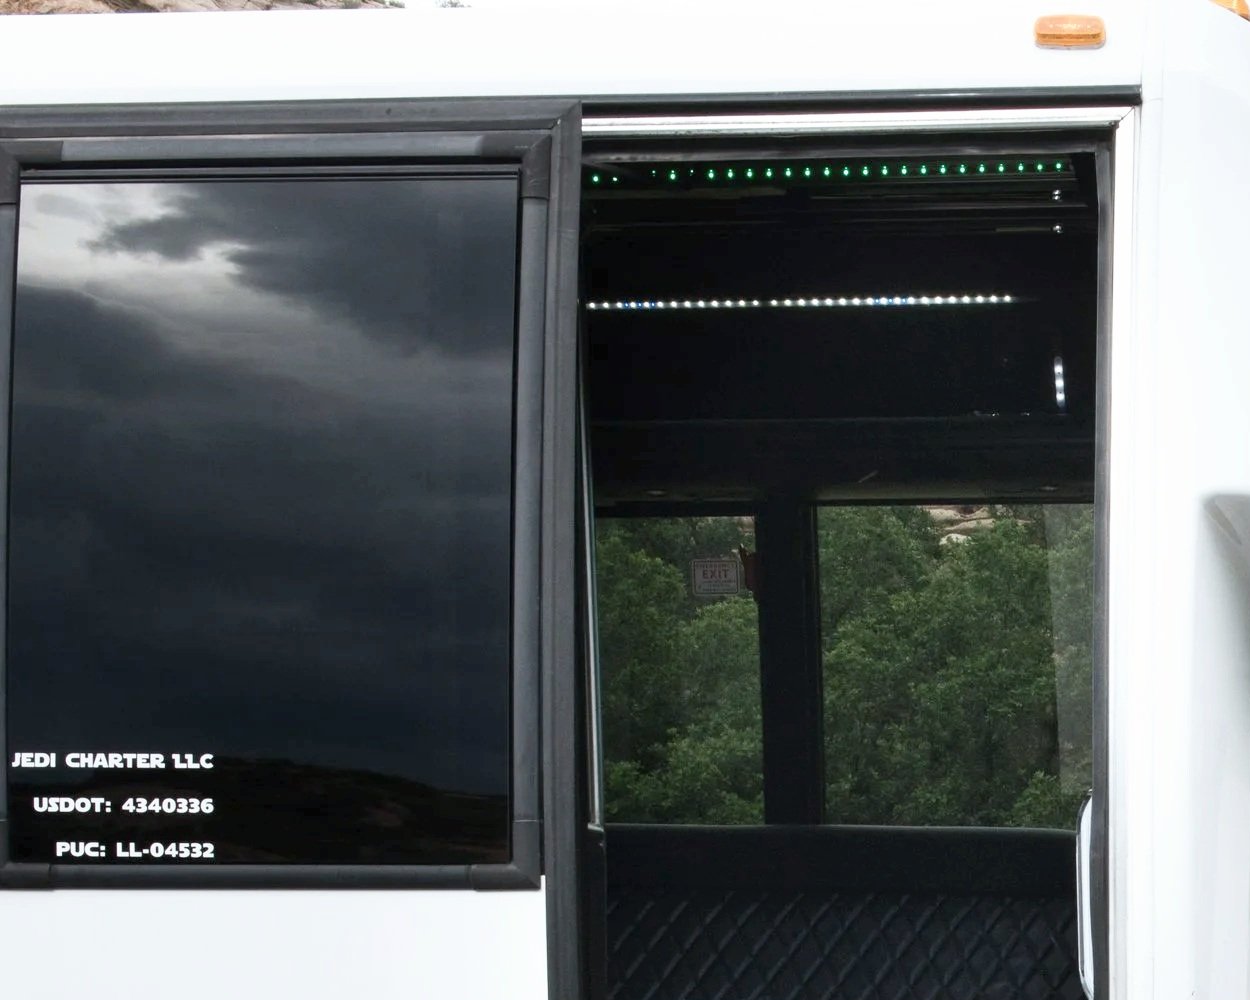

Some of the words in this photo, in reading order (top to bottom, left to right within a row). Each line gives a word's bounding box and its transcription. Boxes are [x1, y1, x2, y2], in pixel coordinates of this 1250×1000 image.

[703, 569, 729, 579] EXIT
[11, 752, 57, 768] JEDI
[65, 752, 166, 769] CHARTER
[172, 753, 214, 769] LLC
[33, 797, 112, 813] USDOT:
[121, 797, 215, 814] 4340336
[56, 841, 106, 857] PUC:
[116, 842, 215, 858] LL-04532
